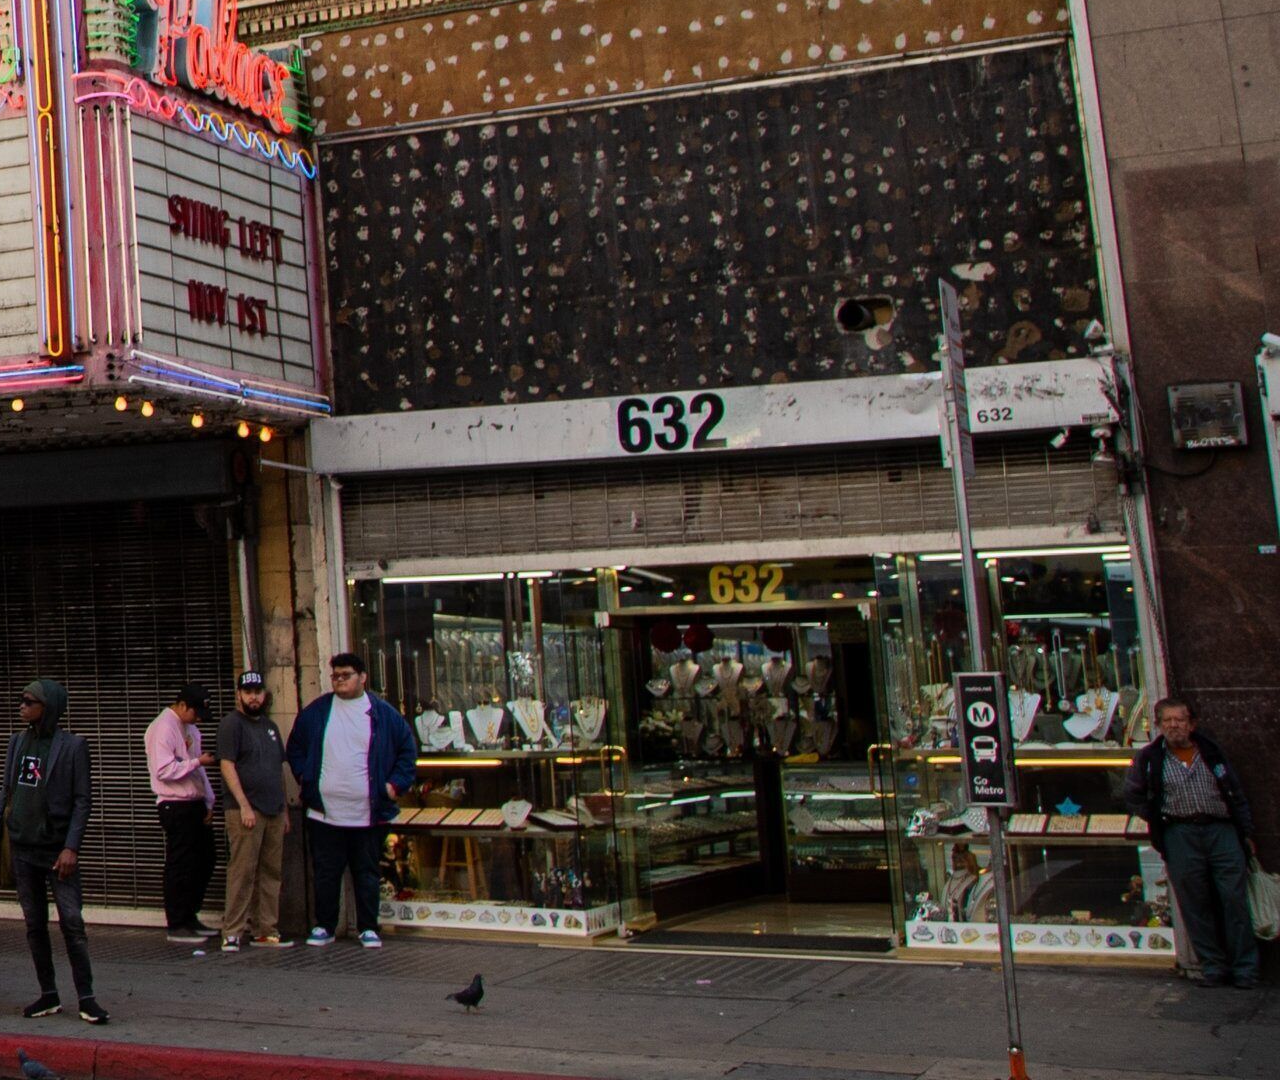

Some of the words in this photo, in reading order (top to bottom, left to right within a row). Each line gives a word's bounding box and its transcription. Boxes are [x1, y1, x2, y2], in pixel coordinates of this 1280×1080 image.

[167, 194, 230, 249] SWING
[239, 216, 284, 265] LEFT
[616, 393, 728, 454] 632
[977, 407, 1013, 423] 632
[709, 563, 786, 604] 632
[972, 706, 991, 723] M
[973, 776, 988, 786] Go
[975, 786, 1004, 796] Metro
